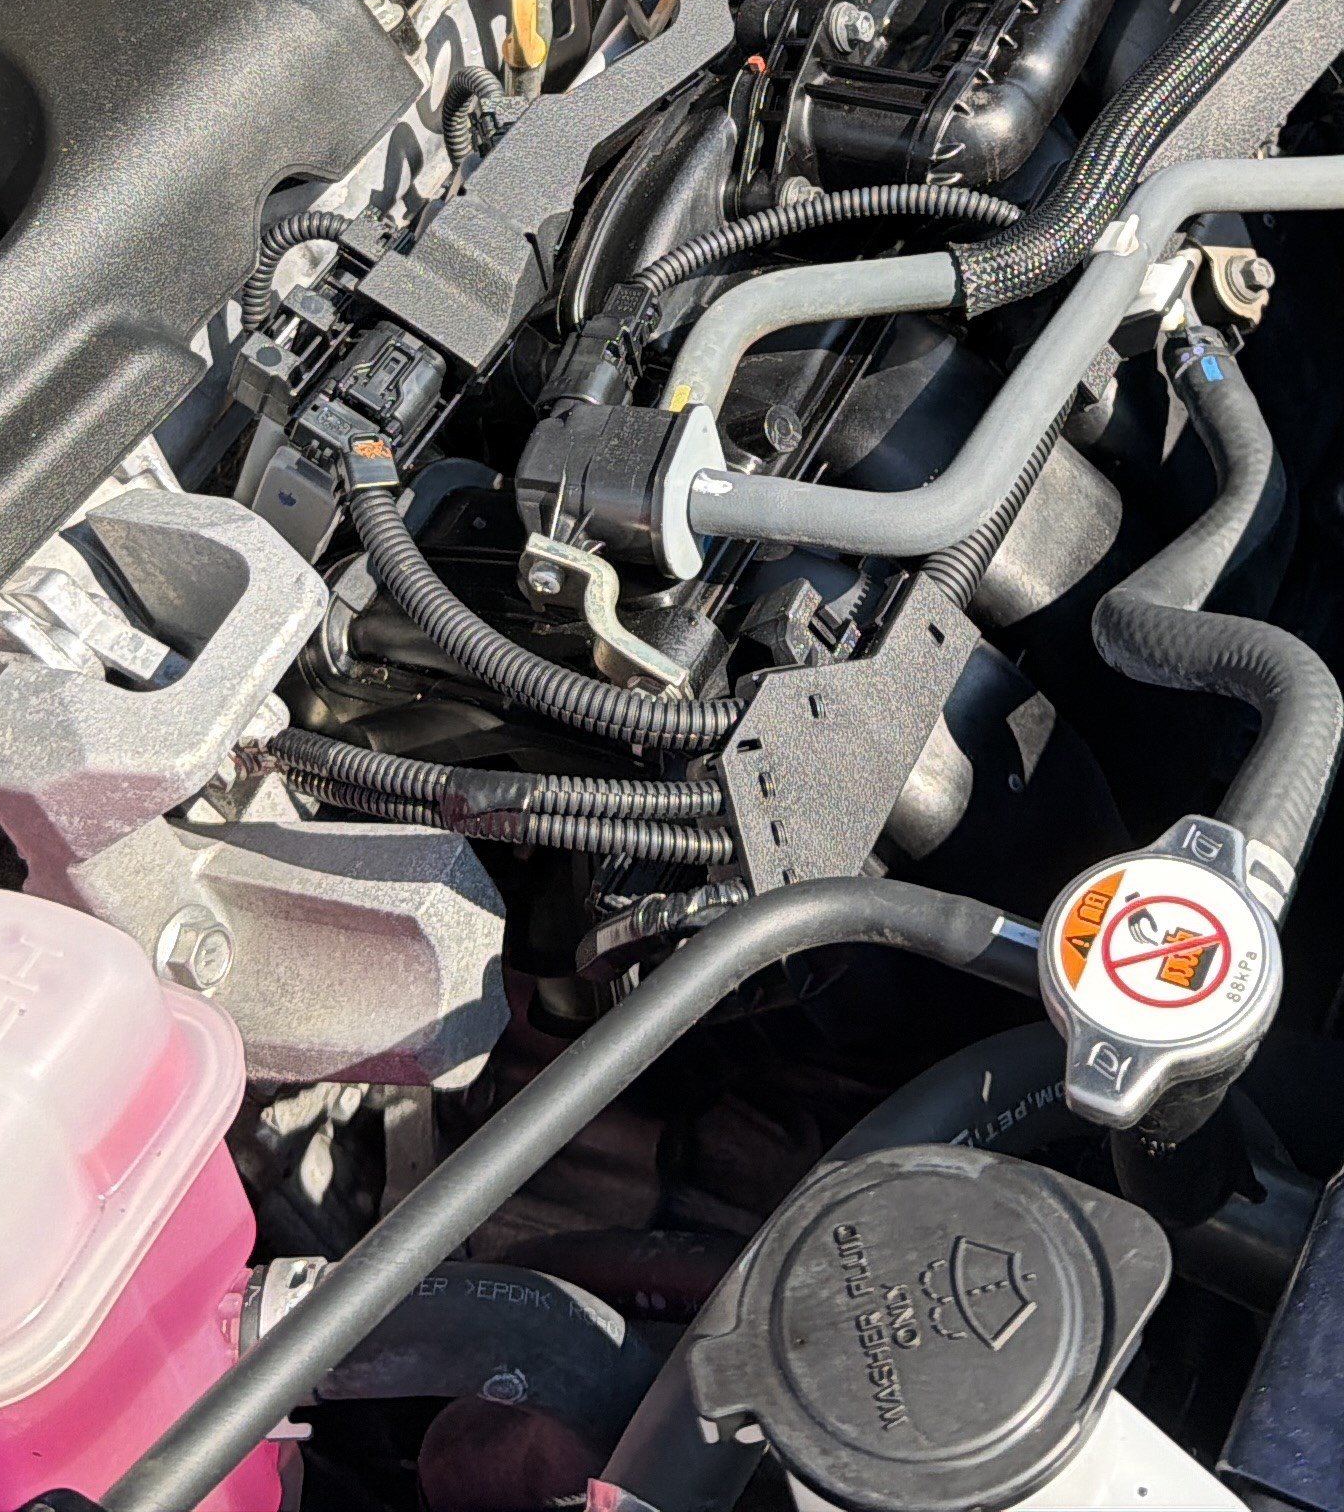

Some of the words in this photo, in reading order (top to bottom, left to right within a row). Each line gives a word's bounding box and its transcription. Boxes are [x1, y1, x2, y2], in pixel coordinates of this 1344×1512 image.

[1225, 950, 1258, 1004] 88kPa
[832, 1222, 875, 1299] FLUID
[881, 1283, 921, 1349] ONLY
[856, 1311, 908, 1431] WASHER
